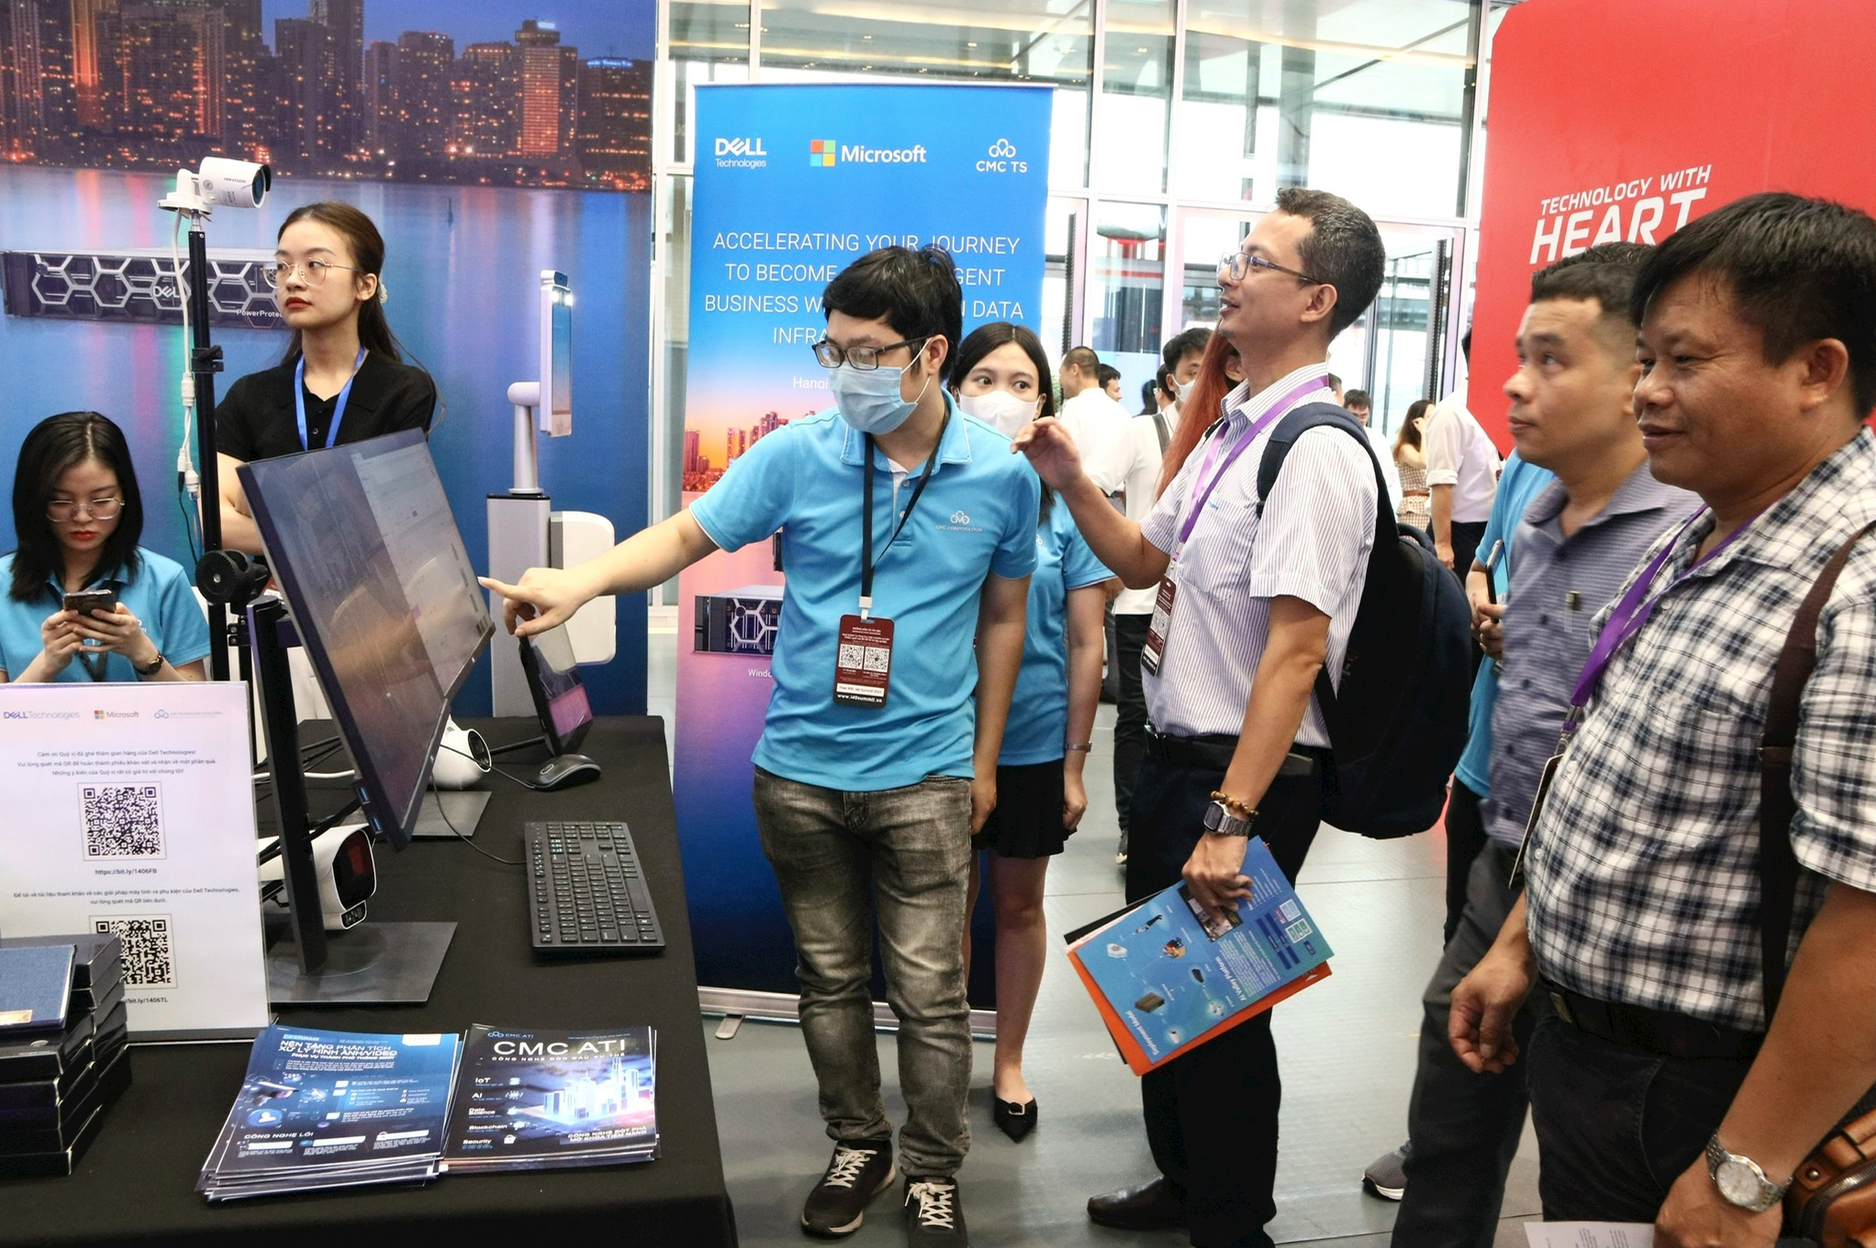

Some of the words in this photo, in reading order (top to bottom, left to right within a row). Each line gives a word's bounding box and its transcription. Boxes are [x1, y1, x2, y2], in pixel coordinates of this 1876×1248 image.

[715, 138, 766, 156] DELL
[842, 144, 926, 162] Microsoft
[715, 158, 766, 169] Technologies
[976, 160, 1006, 172] CMC
[1011, 162, 1027, 173] TS
[1540, 177, 1653, 216] TECHNOLOGY
[1660, 164, 1712, 192] WITH
[1529, 187, 1708, 264] HEART
[713, 232, 859, 251] ACCELERATING
[866, 235, 919, 251] YOUR
[930, 236, 1019, 255] JOURNEY
[725, 264, 750, 280] TO
[756, 264, 837, 282] BECOME
[153, 285, 180, 298] DEL
[705, 296, 798, 312] BUSINESS
[973, 300, 1024, 319] DATA
[236, 309, 283, 318] PowerProtec
[793, 376, 828, 389] Hanoi
[748, 668, 772, 678] Windo
[29, 711, 79, 720] Technologies
[1214, 955, 1233, 980] Platform
[1228, 977, 1244, 996] Valley
[1238, 994, 1247, 1002] AI
[1125, 1009, 1140, 1027] Model
[493, 1041, 568, 1056] CMC
[577, 1039, 625, 1053] ATI
[1136, 1023, 1160, 1056] Deployment
